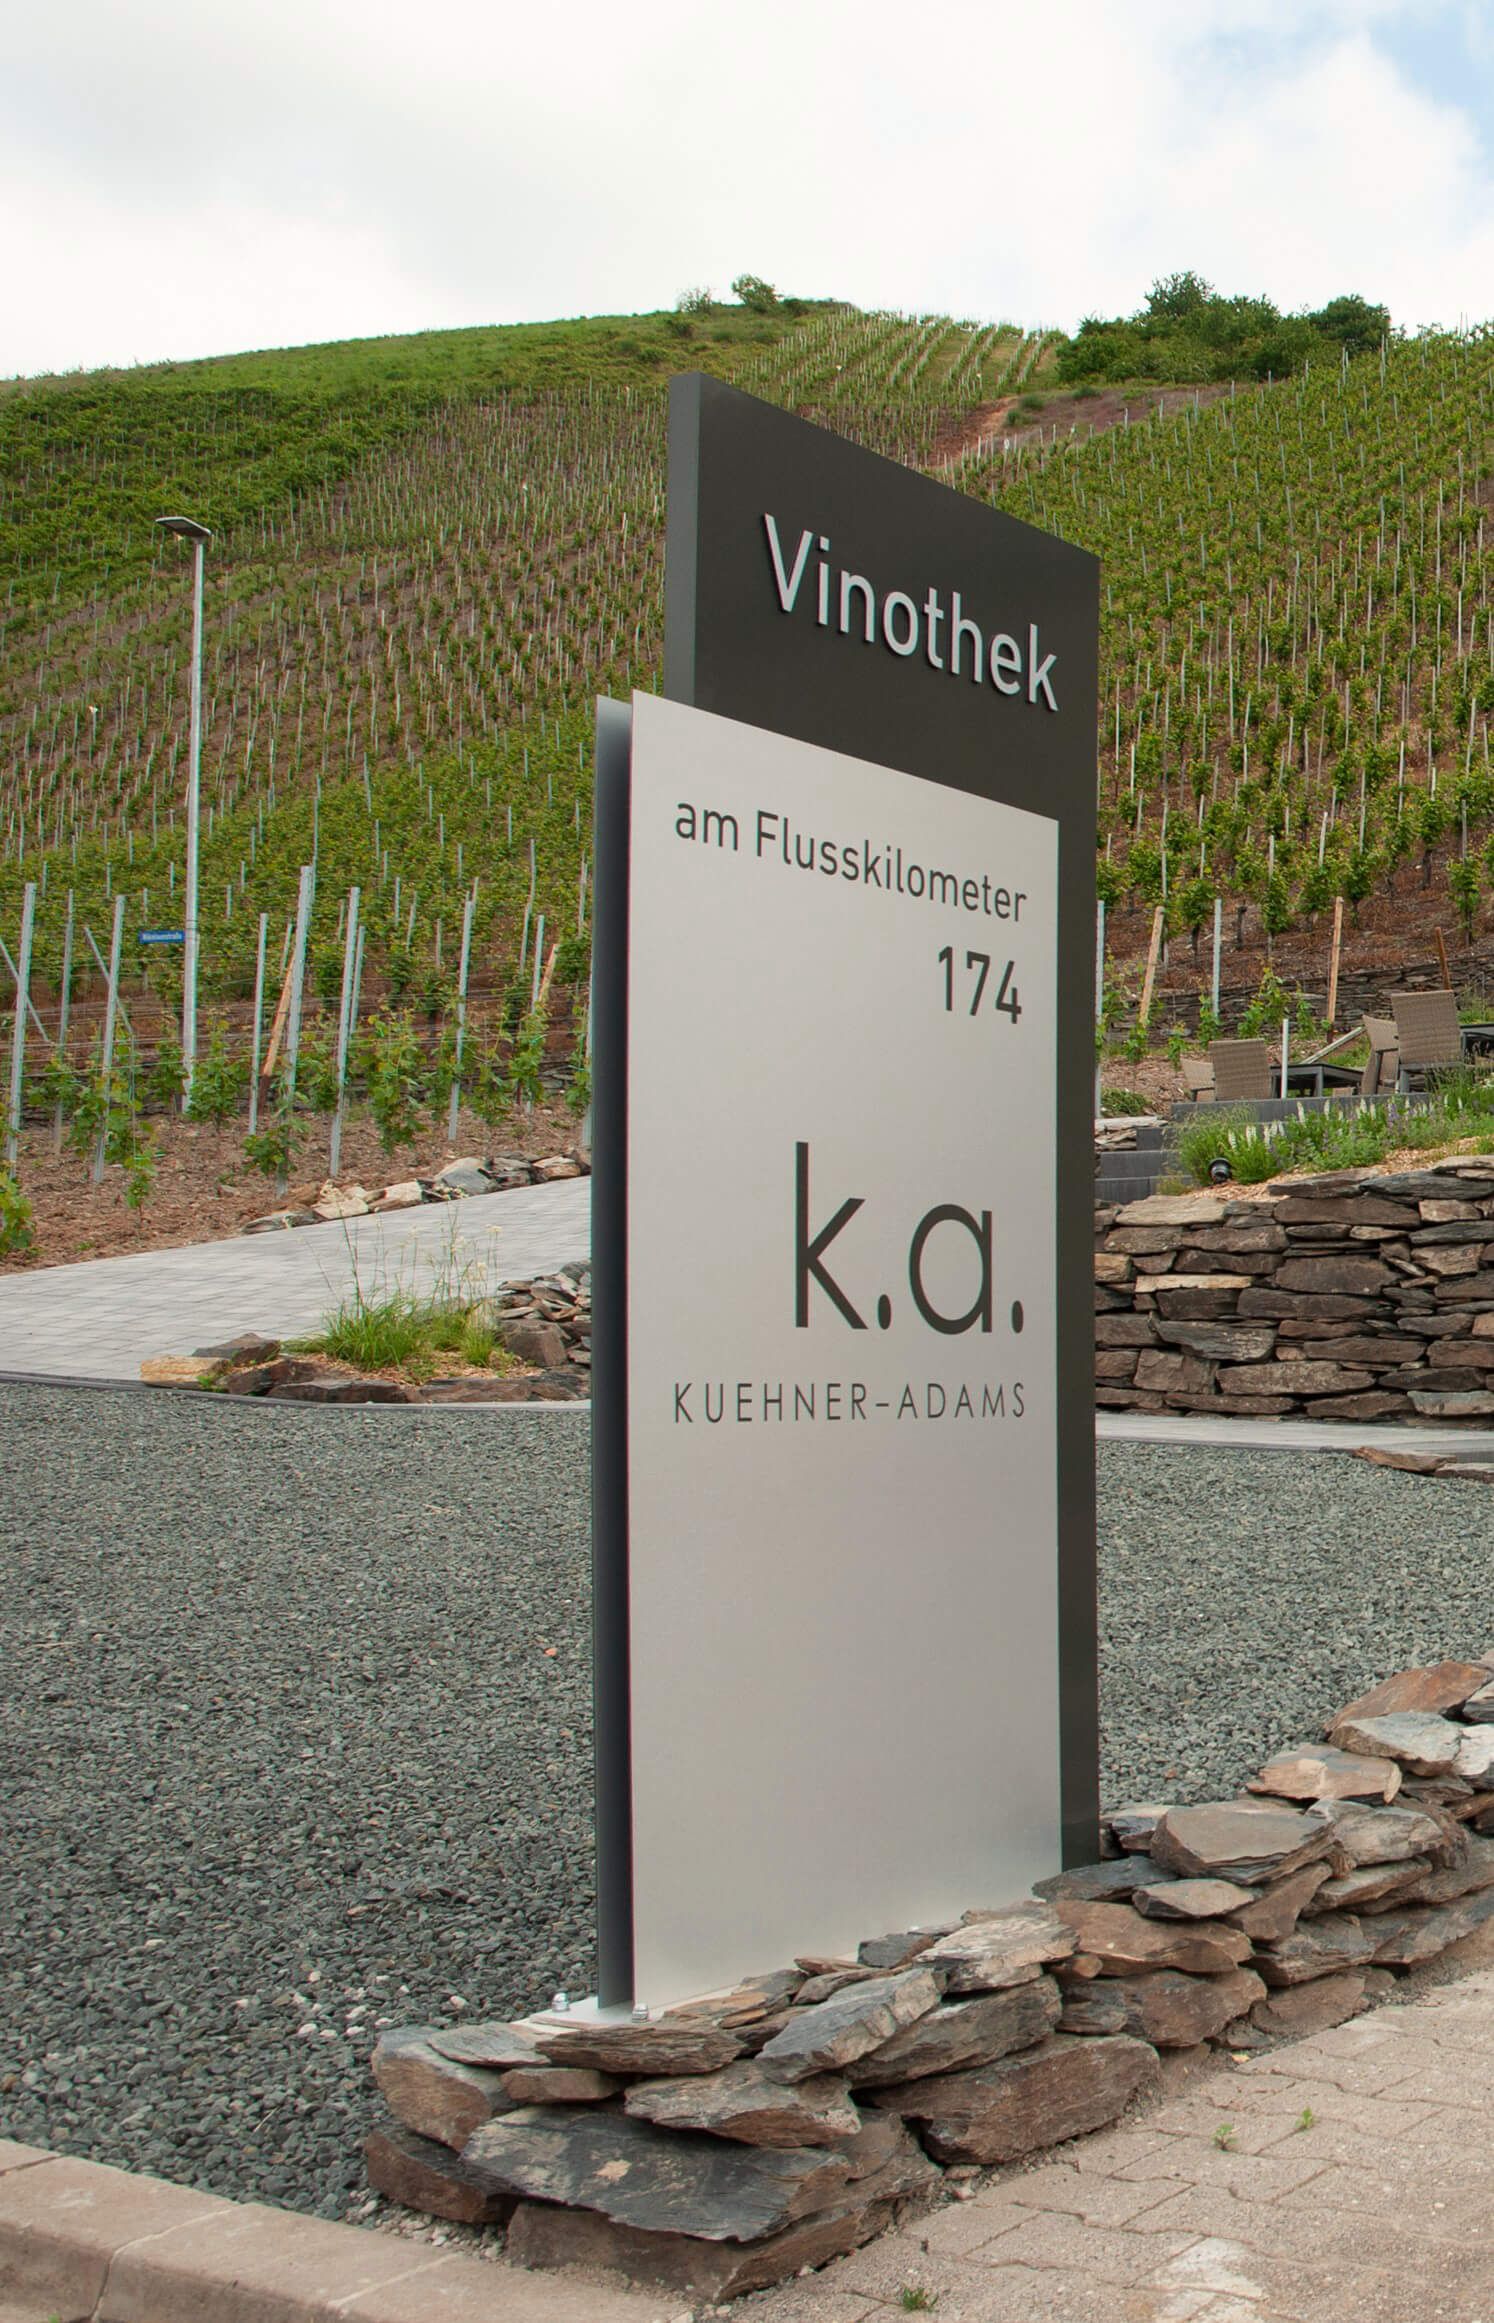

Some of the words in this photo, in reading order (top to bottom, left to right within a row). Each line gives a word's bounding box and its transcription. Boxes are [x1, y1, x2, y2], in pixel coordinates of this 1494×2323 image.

[763, 513, 1059, 712] Vinothek
[675, 801, 738, 857] am
[755, 809, 1027, 922] Flusskilometer
[938, 945, 1022, 1024] 174
[795, 1141, 1024, 1335] k.a.
[674, 1382, 1025, 1424] KUEHNER-ADAMS
